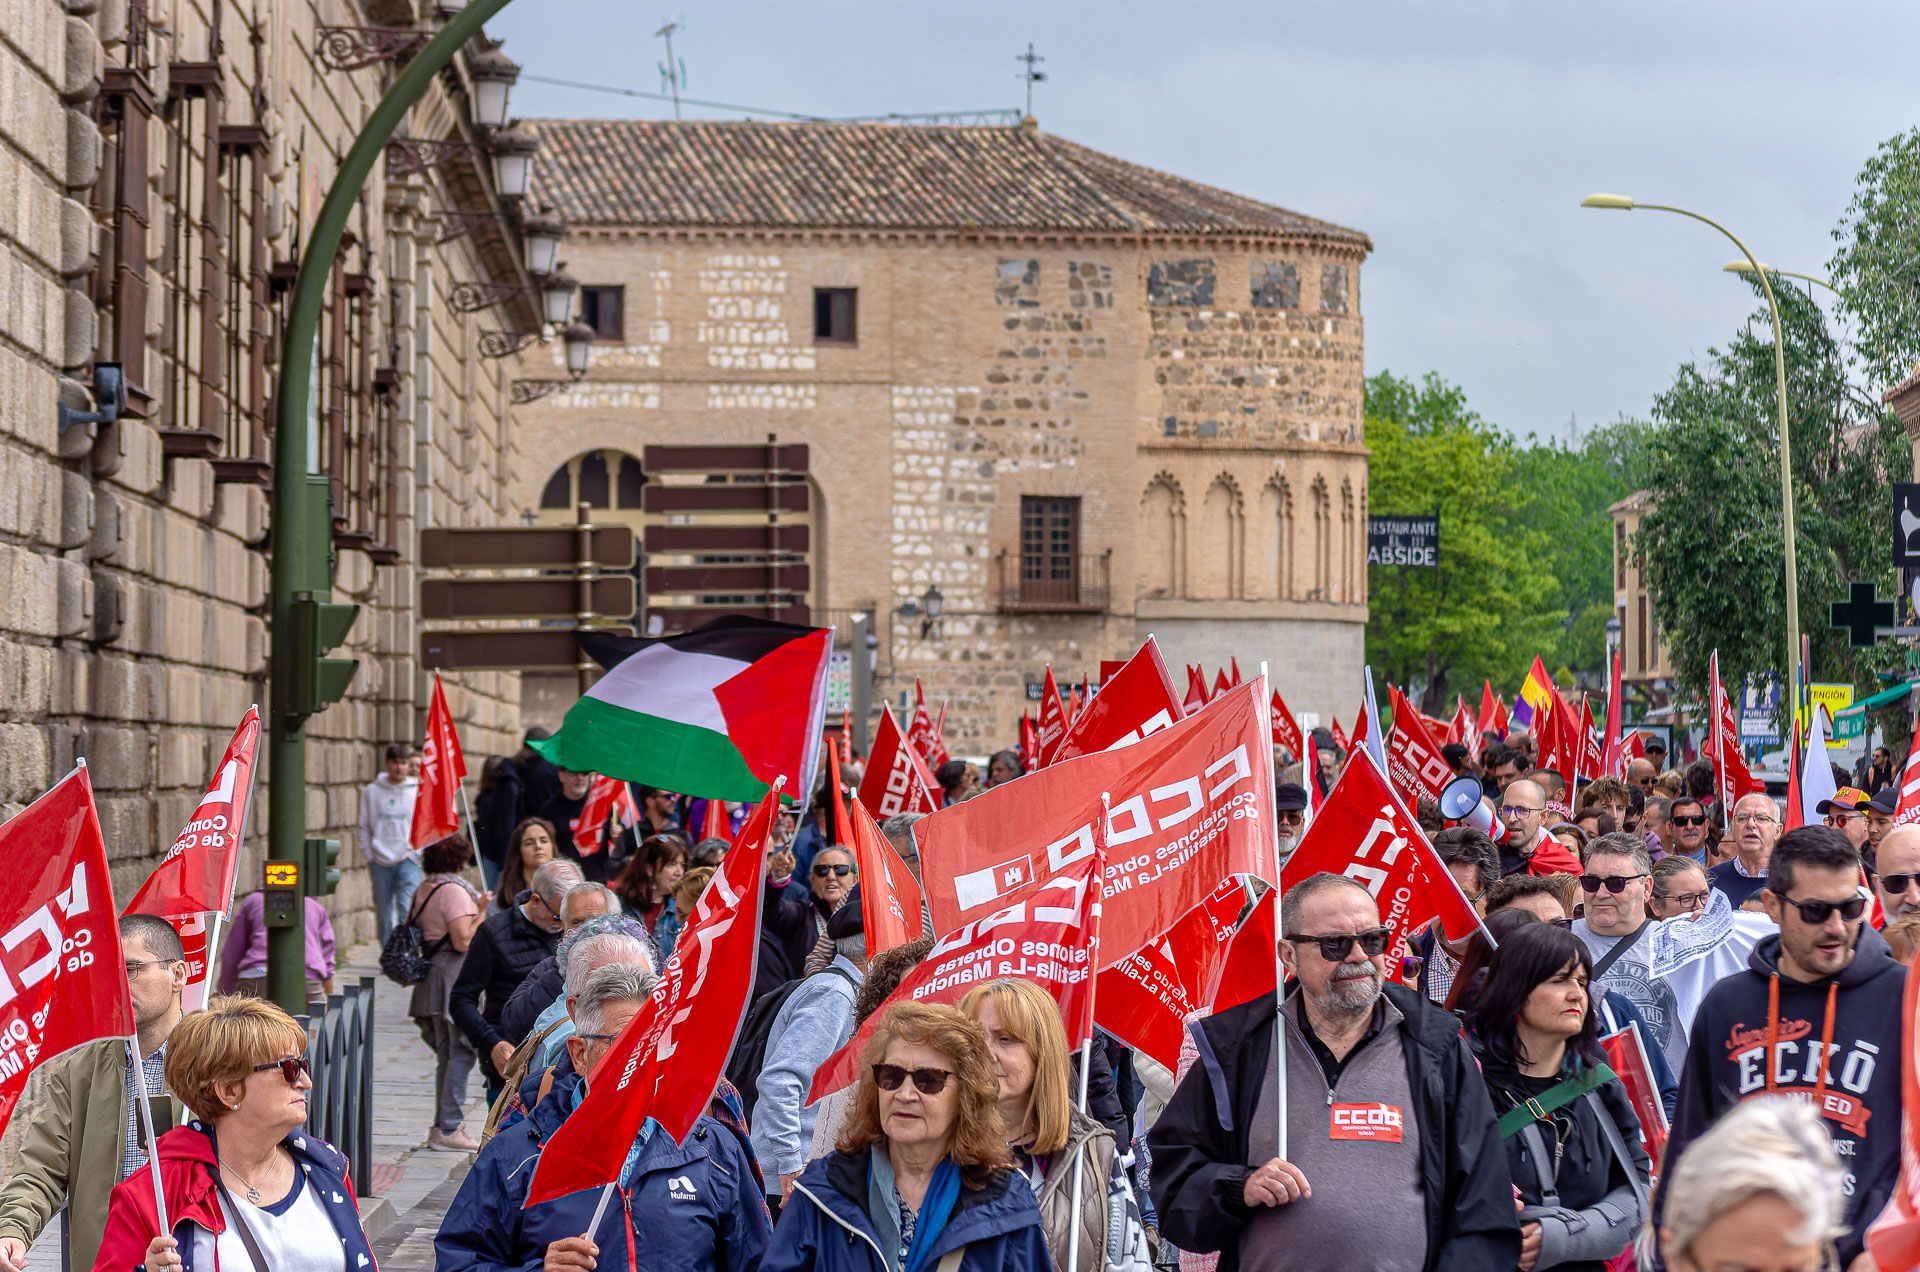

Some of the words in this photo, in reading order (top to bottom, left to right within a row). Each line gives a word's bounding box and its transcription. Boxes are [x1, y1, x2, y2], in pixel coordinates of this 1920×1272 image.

[1812, 689, 1846, 701] ENCIÓN
[1334, 1109, 1400, 1126] CCOO
[670, 1191, 697, 1201] Nufarm
